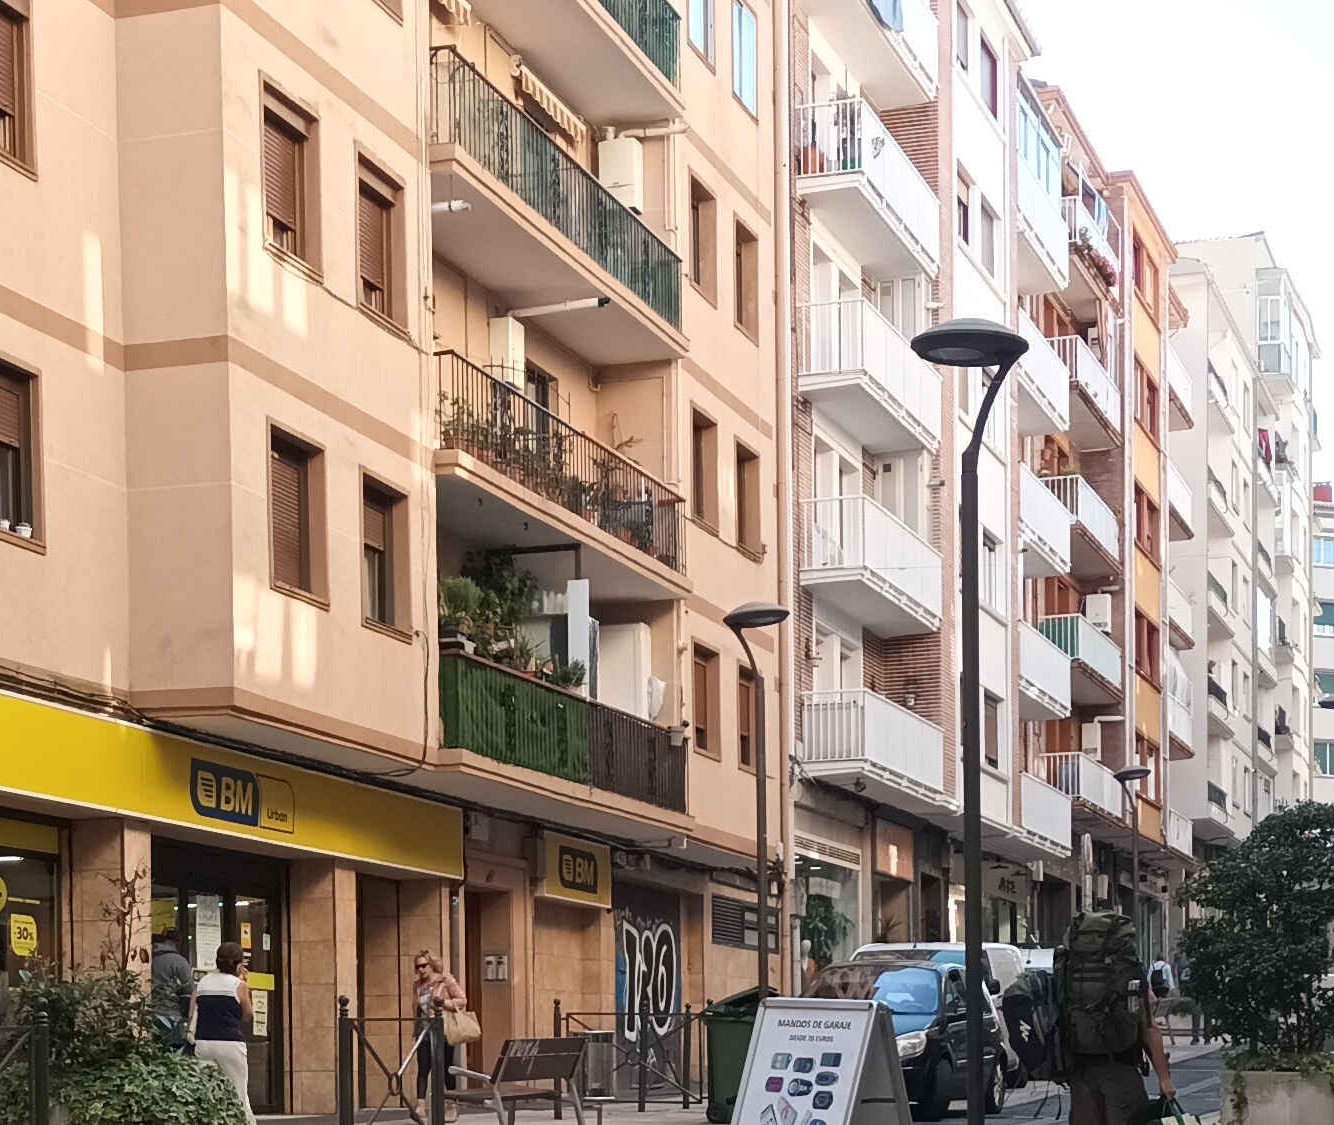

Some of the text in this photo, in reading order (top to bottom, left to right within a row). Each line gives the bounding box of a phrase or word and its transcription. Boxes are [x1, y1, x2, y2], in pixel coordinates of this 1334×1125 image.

[220, 776, 253, 817] BM
[267, 808, 288, 823] Urban
[575, 856, 595, 887] BM
[777, 1019, 852, 1030] MANDOS DE GARAJE
